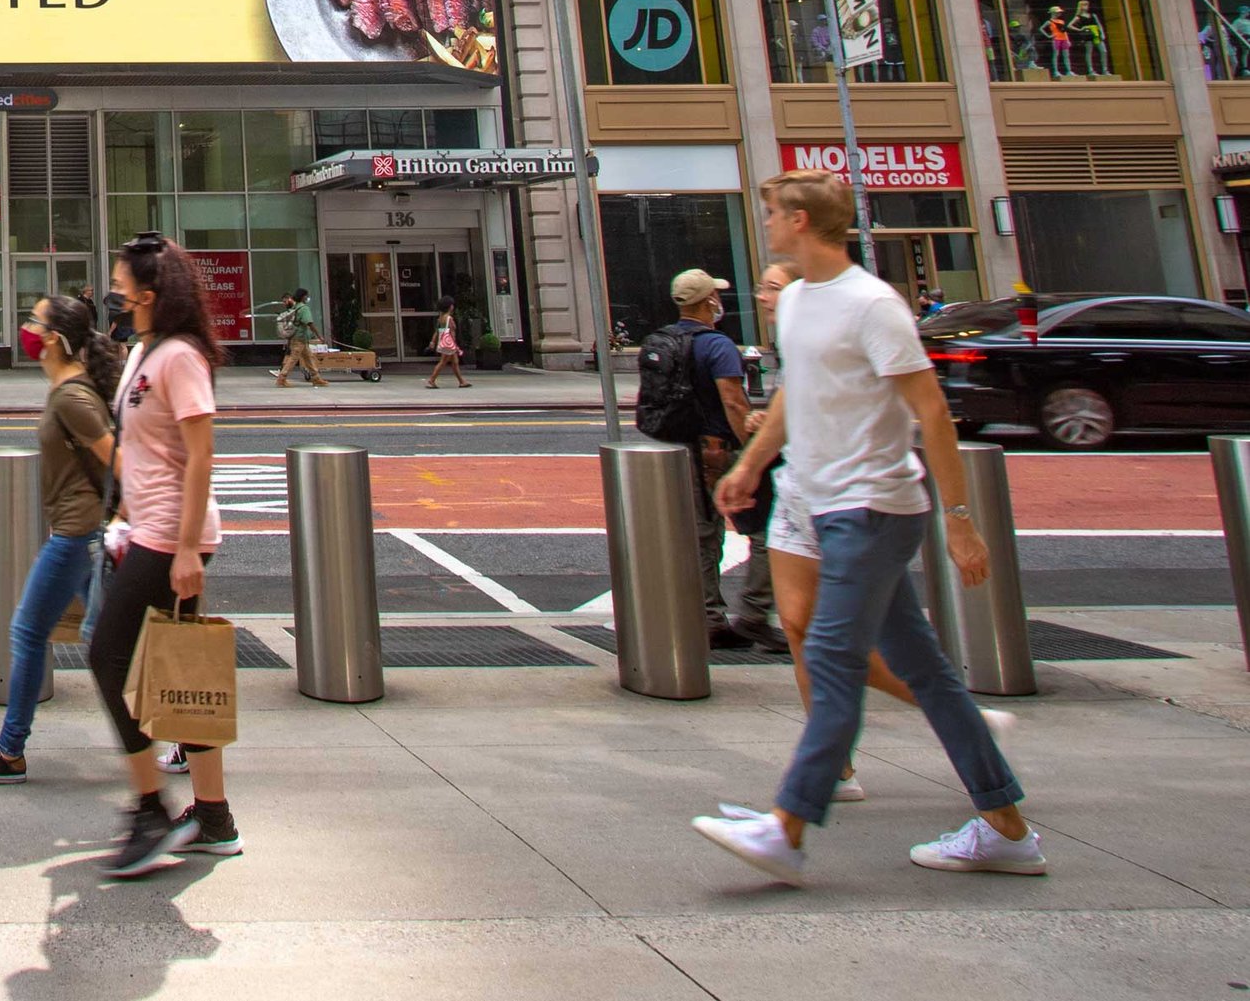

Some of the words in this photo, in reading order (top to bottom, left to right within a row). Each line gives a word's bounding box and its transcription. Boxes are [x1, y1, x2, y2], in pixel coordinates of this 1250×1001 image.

[623, 8, 682, 51] JD
[397, 157, 463, 174] Hilton
[466, 157, 538, 174] Garden
[541, 157, 575, 174] Inn
[888, 172, 949, 185] GOODS
[385, 212, 415, 227] 136
[205, 283, 235, 291] LEASE
[160, 690, 213, 706] FOREVER
[215, 691, 228, 706] 21
